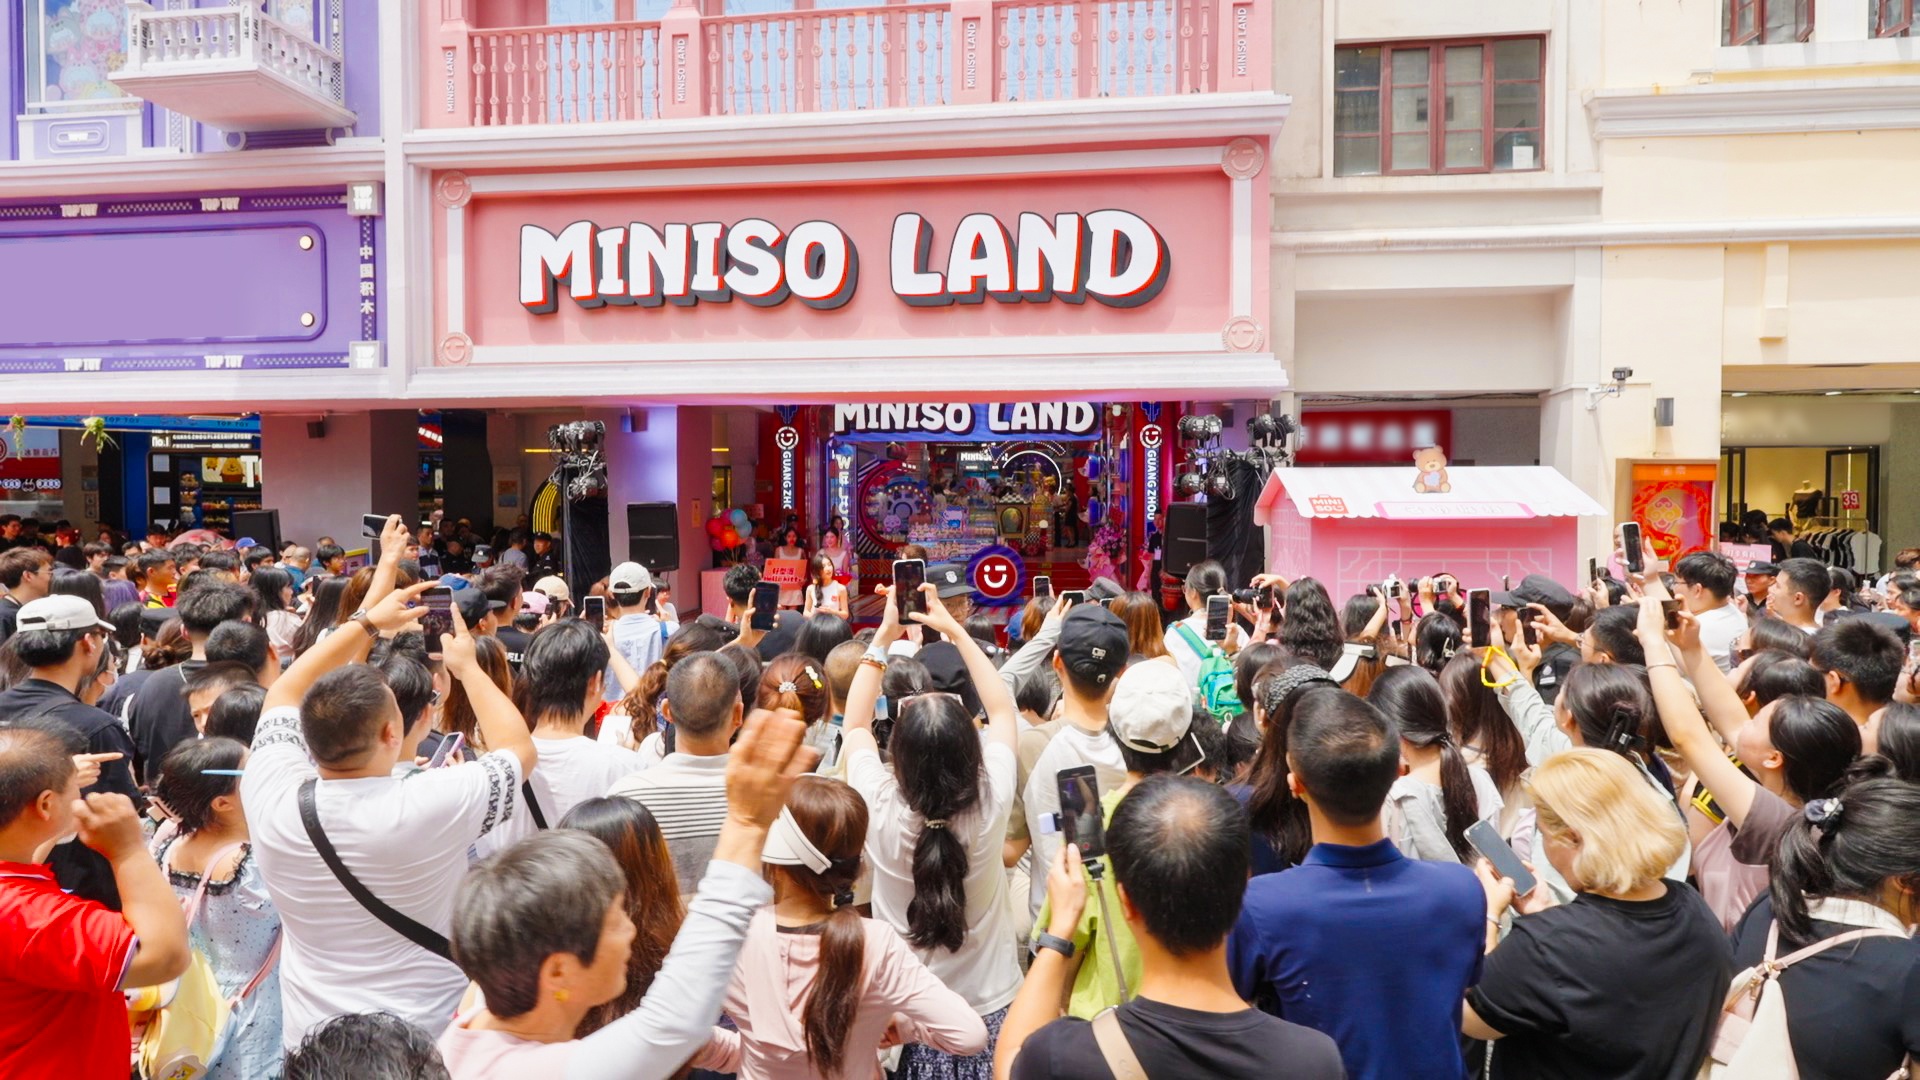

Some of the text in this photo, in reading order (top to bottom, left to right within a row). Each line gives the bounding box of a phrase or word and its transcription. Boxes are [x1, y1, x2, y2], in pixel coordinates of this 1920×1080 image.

[677, 39, 686, 102] MINISO LAND
[967, 22, 976, 88] MINISO LAND
[1237, 8, 1247, 75] MINISO LAND
[447, 51, 455, 113] MINISO LAND
[60, 203, 98, 217] TOP TOY
[200, 197, 240, 211] TOP TOY
[360, 245, 374, 314] 中国积木
[520, 209, 1171, 310] MINISO LAND
[64, 358, 101, 371] TOP TOY
[204, 355, 243, 368] TOP TOY
[835, 401, 1095, 434] MINISO LAND
[782, 451, 792, 510] GUANG ZHO
[1147, 450, 1157, 520] GUANG ZHOU
[1843, 493, 1858, 505] 39
